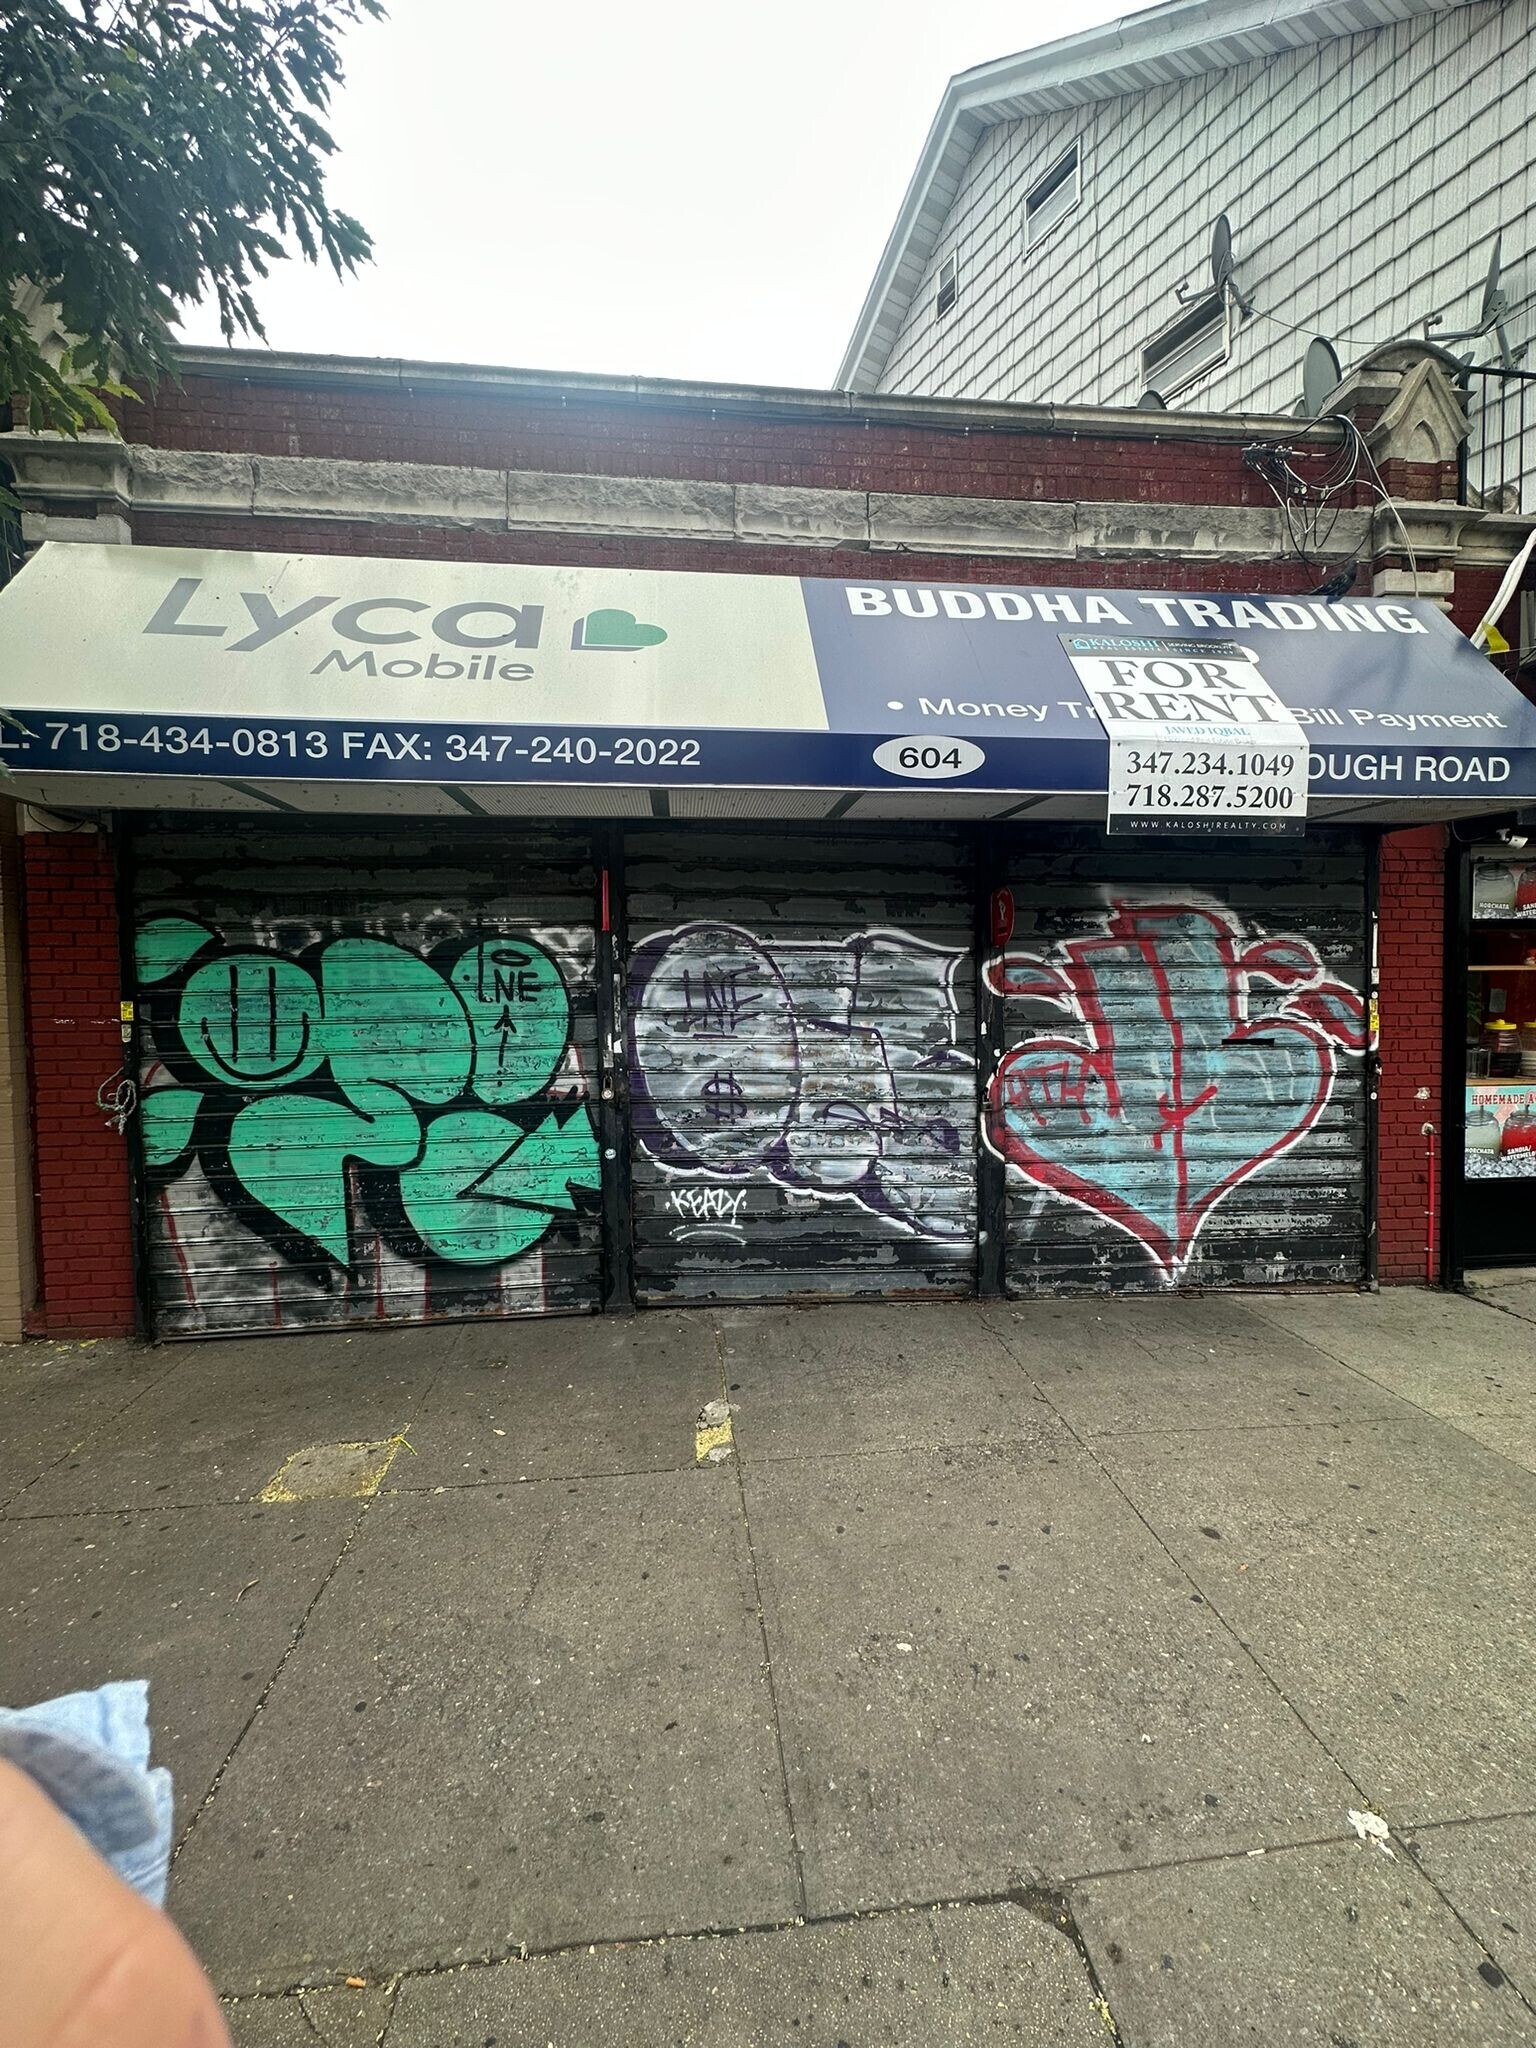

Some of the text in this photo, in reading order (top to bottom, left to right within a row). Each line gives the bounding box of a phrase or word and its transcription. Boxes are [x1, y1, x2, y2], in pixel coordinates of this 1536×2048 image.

[142, 577, 544, 652] Lyca
[845, 586, 1430, 634] BUDDHA TRADING
[1089, 638, 1159, 648] KALOSHI
[310, 650, 534, 681] Mobile
[1099, 660, 1246, 690] FOR
[918, 697, 1048, 722] Money
[1095, 692, 1279, 723] RENT
[1286, 707, 1507, 730] Bill Payment
[1165, 726, 1251, 736] JAVED IQBAL
[45, 722, 328, 758] 718-434-0813
[343, 732, 432, 761] FAX:
[446, 734, 701, 766] 347-240-2022
[899, 748, 962, 768] 604
[1126, 752, 1294, 776] 347.234.1049
[1415, 756, 1510, 782] ROAD
[1126, 784, 1293, 808] 718.287.5200
[1130, 821, 1287, 831] WWW.KALOSHIREALTY.COM
[1471, 1094, 1525, 1105] HOMEMADE
